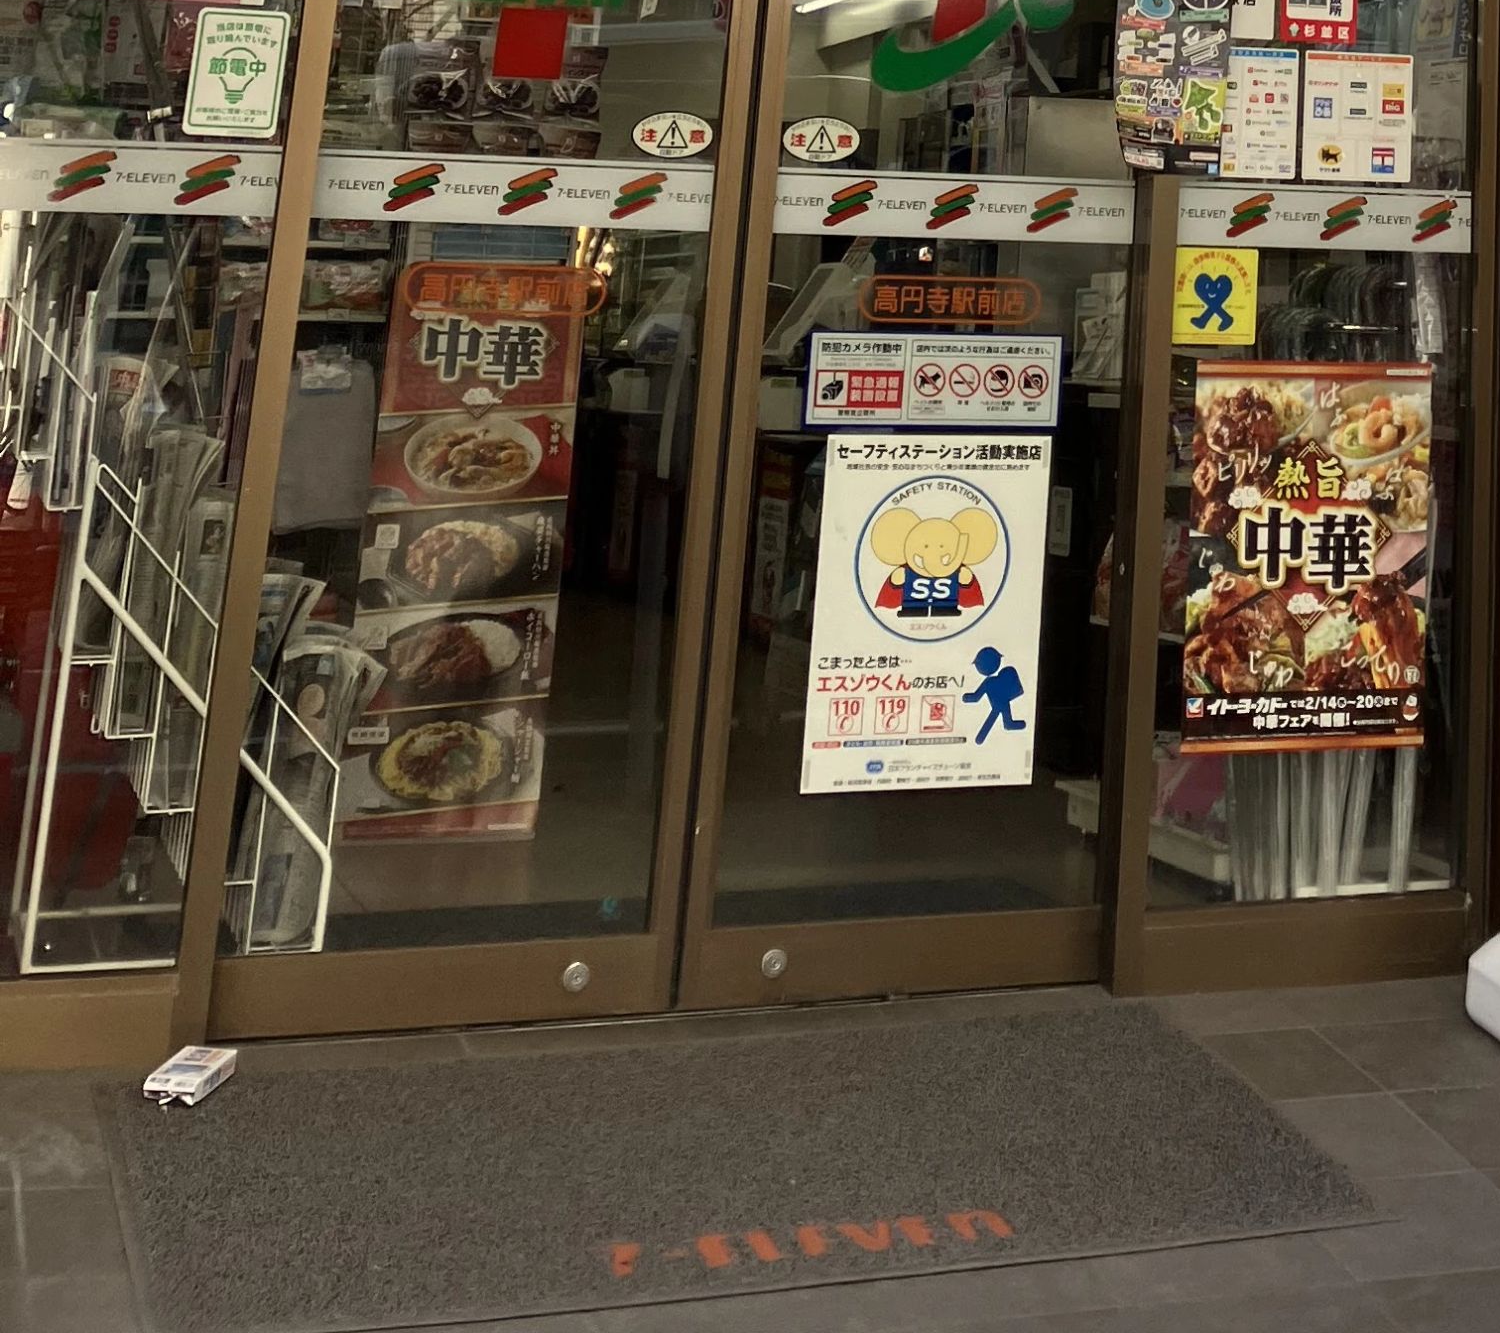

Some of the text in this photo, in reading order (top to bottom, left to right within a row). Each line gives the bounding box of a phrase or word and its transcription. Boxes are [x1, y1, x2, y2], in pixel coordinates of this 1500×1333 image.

[1304, 23, 1350, 39] 杉並区
[208, 57, 267, 77] 節電中
[873, 284, 1026, 317] 高円寺駅前店
[424, 318, 545, 387] 中華
[821, 341, 904, 355] 防犯カメラ作動中
[836, 443, 1043, 461] セーフティステーション活動実施店
[1273, 456, 1345, 500] 熱旨
[891, 481, 982, 506] SAFETY STATION
[1243, 506, 1374, 591] 中華
[832, 698, 907, 716] 110 119
